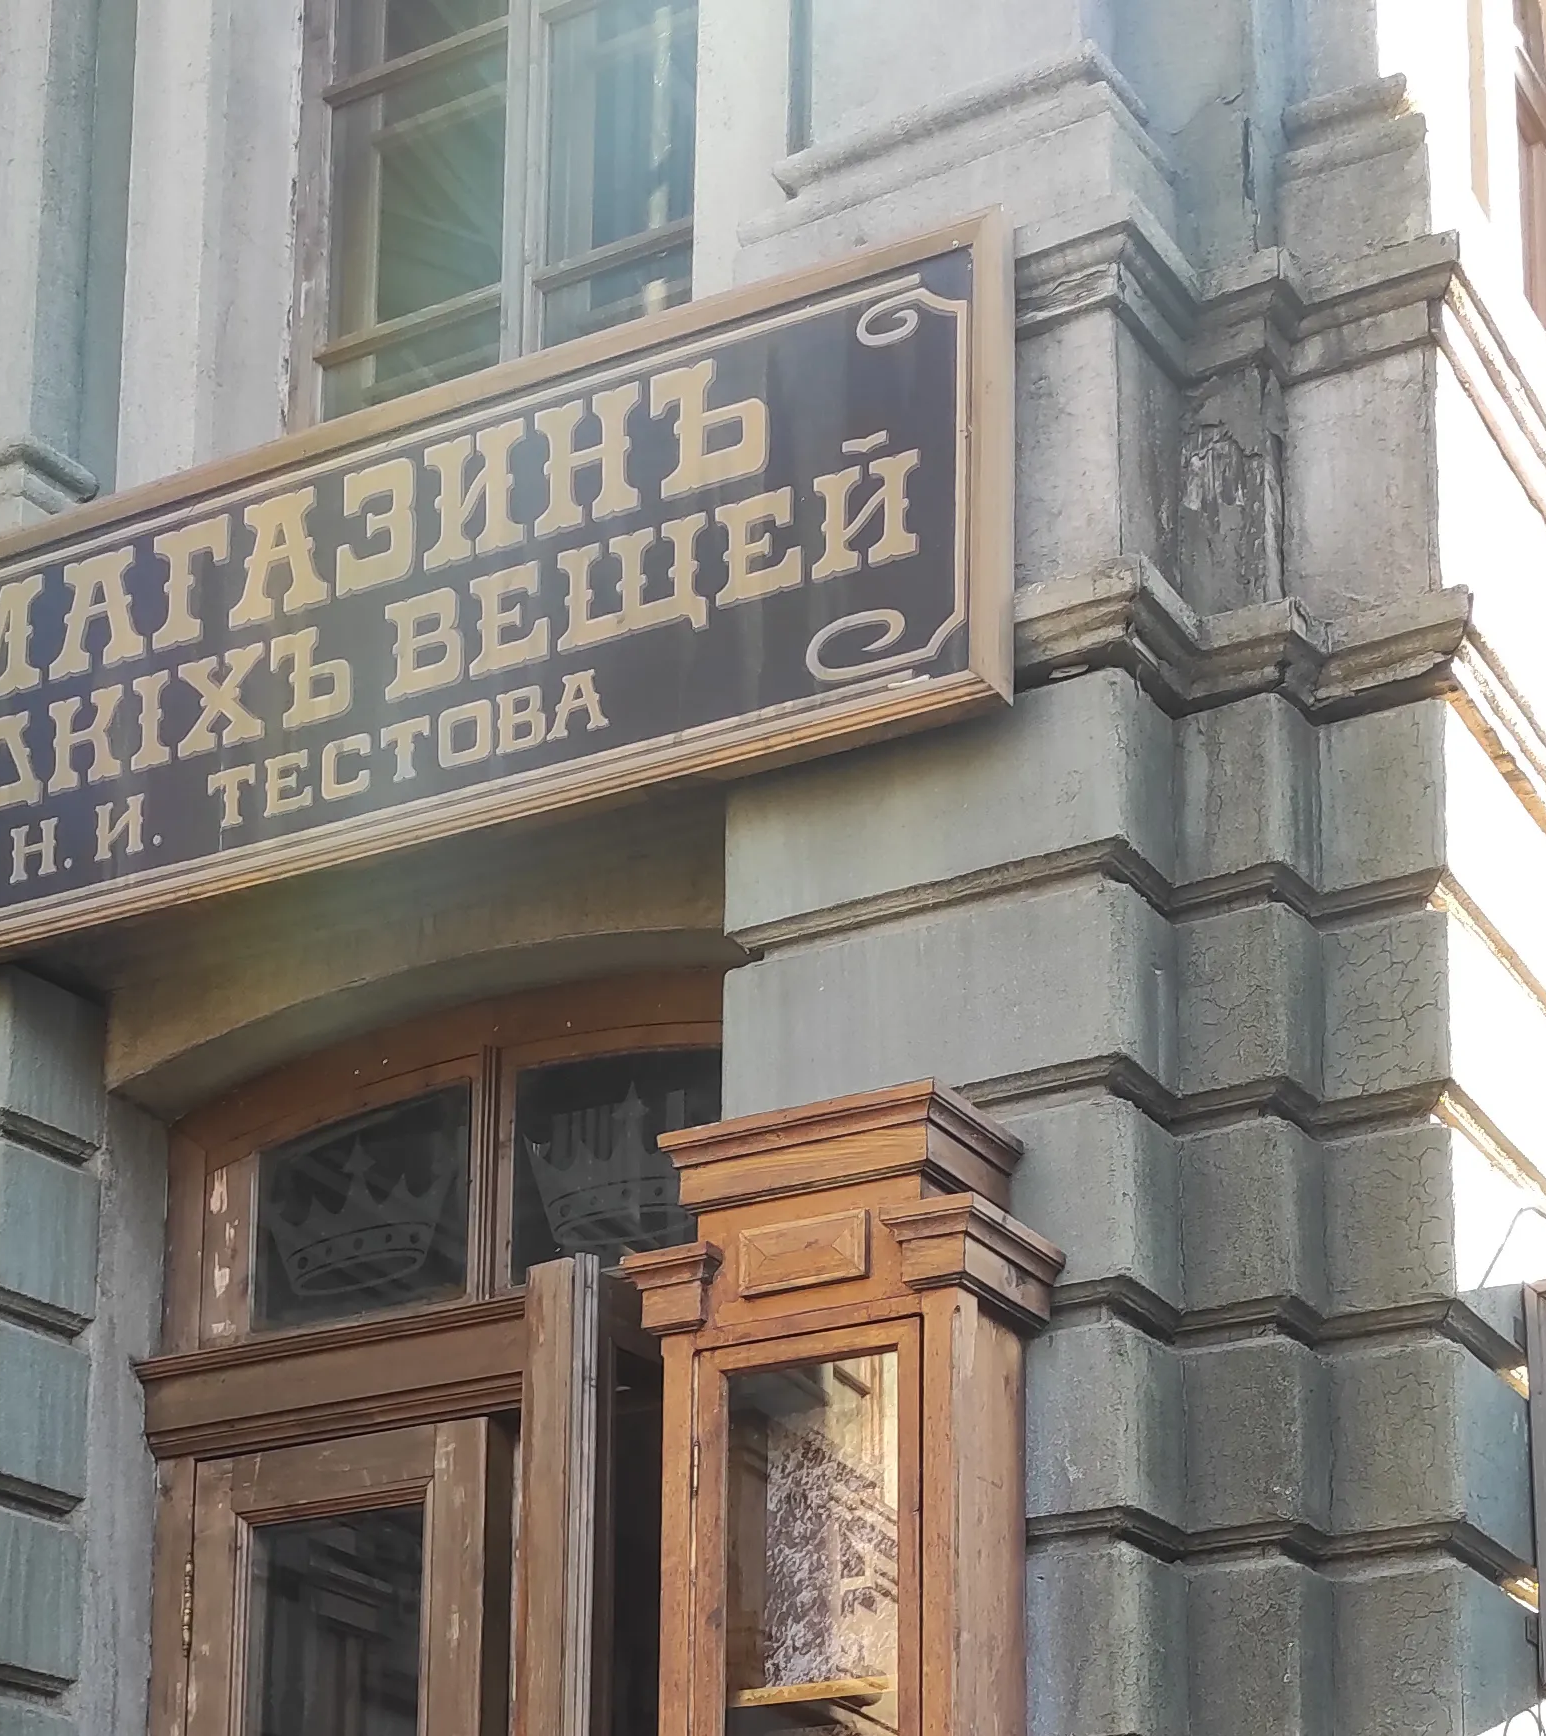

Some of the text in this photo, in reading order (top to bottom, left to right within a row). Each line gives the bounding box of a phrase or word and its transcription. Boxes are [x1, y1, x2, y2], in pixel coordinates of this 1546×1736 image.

[384, 429, 920, 702] ВЕЩЕЙ
[9, 668, 610, 885] Н. И. ТЕСТОВА
